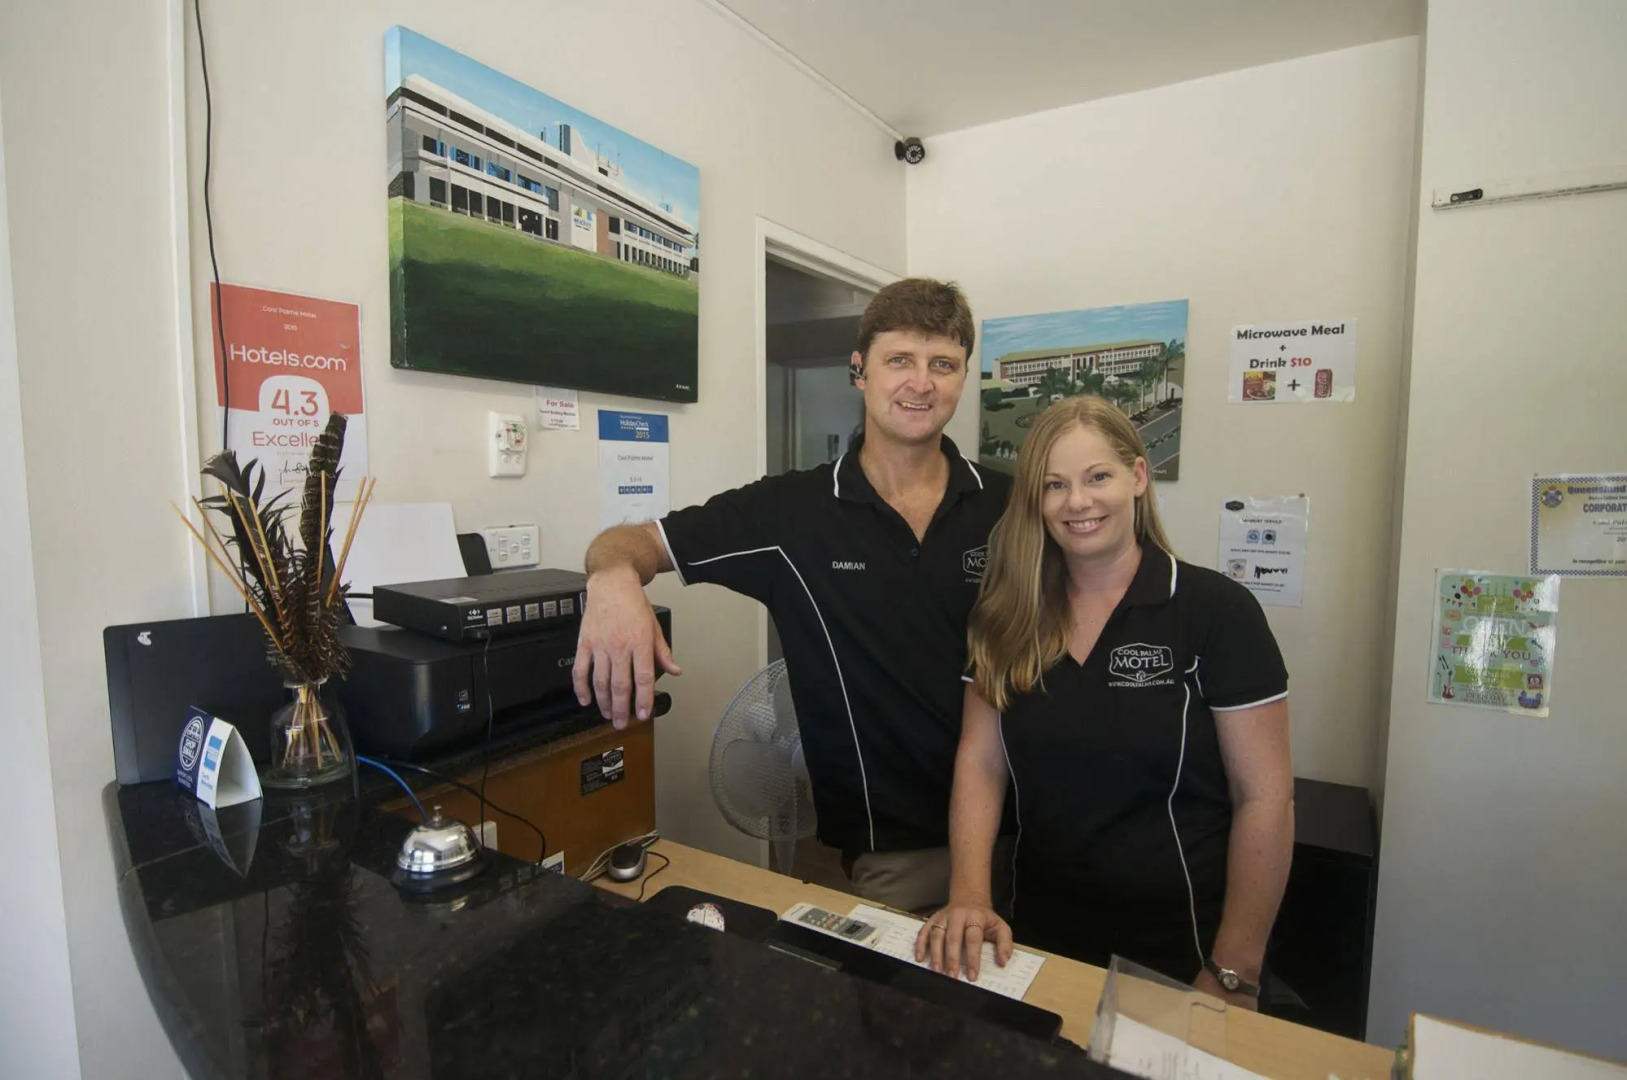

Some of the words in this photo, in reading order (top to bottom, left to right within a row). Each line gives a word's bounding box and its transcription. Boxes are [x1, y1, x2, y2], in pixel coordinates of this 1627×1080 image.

[1237, 328, 1307, 340] Microwave
[1311, 324, 1345, 336] Meal
[230, 343, 347, 372] Hotels.com
[1250, 357, 1287, 368] Drink
[1290, 357, 1312, 368] $10
[271, 388, 319, 417] 4.3
[273, 418, 294, 427] OUT
[297, 419, 312, 428] OF
[314, 420, 319, 428] 5
[252, 431, 320, 448] Excelle
[635, 430, 650, 439] 2015
[832, 561, 866, 570] DAMIAN
[1113, 654, 1169, 669] MOTEL
[1503, 650, 1531, 660] YOU
